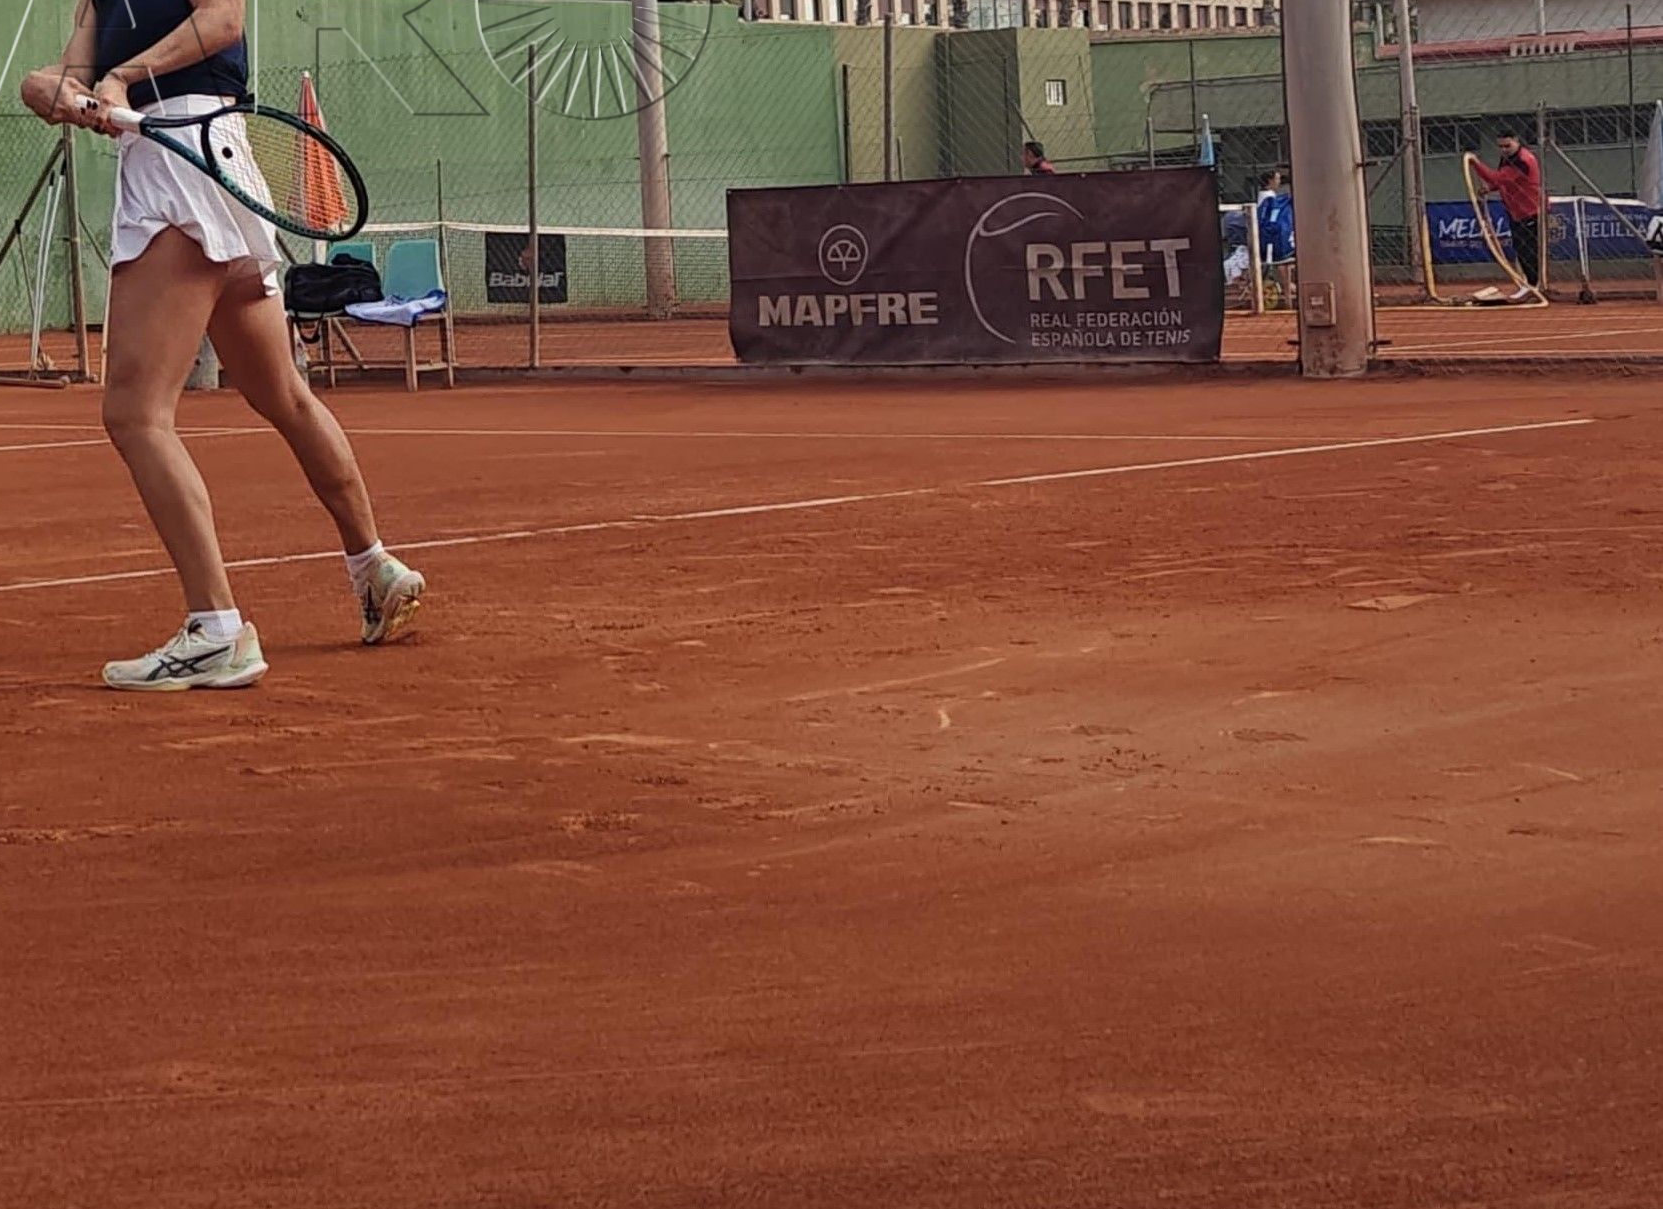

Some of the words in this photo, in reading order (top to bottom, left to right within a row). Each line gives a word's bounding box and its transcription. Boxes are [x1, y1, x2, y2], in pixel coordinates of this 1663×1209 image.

[1026, 238, 1190, 300] RFET
[758, 292, 938, 327] MAPFRE
[1030, 312, 1072, 328] REAL
[1077, 307, 1182, 327] FEDERACIÓN
[1031, 329, 1116, 348] ESPAÑOLA
[1120, 330, 1142, 346] DE
[1146, 329, 1191, 346] TENIS
